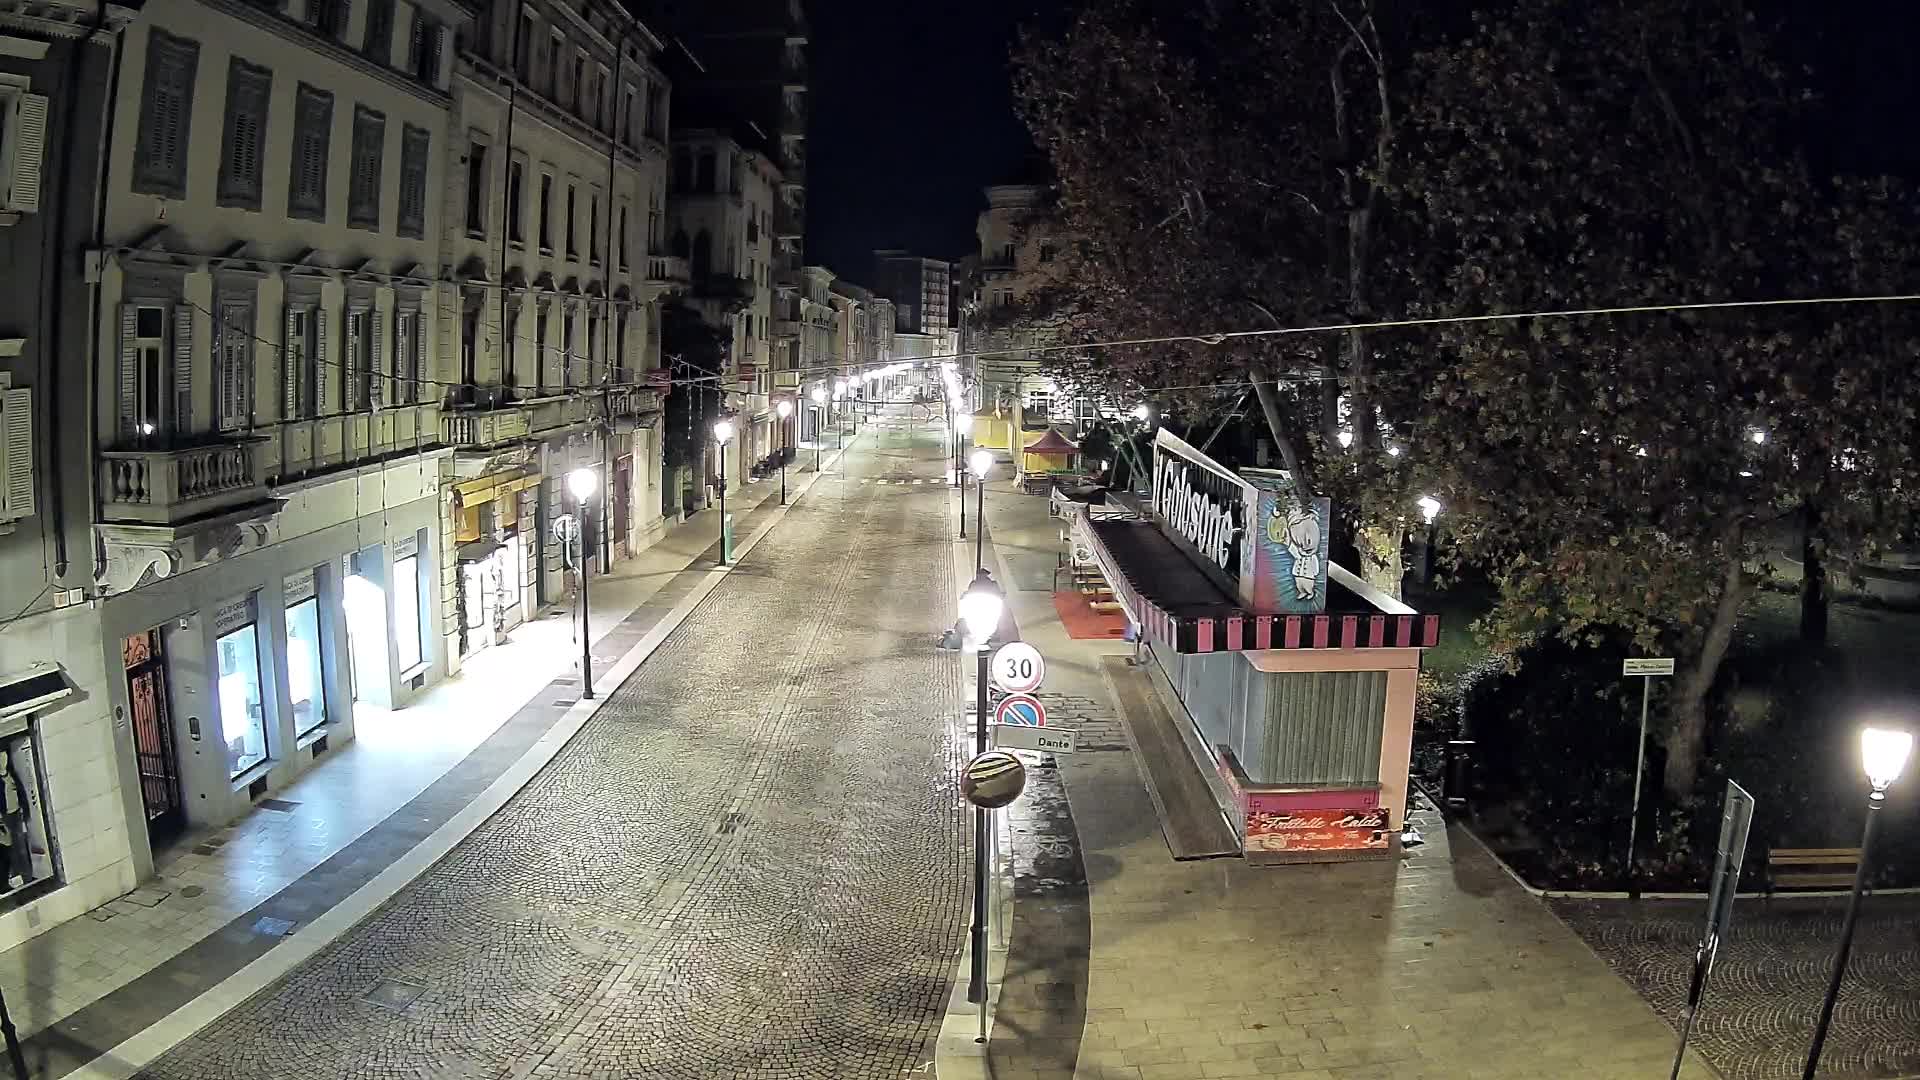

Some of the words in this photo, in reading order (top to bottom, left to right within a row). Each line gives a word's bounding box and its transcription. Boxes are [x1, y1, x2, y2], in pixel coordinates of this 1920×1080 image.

[1163, 458, 1233, 569] Golosone
[1006, 658, 1032, 679] 30
[1038, 737, 1070, 749] Dante
